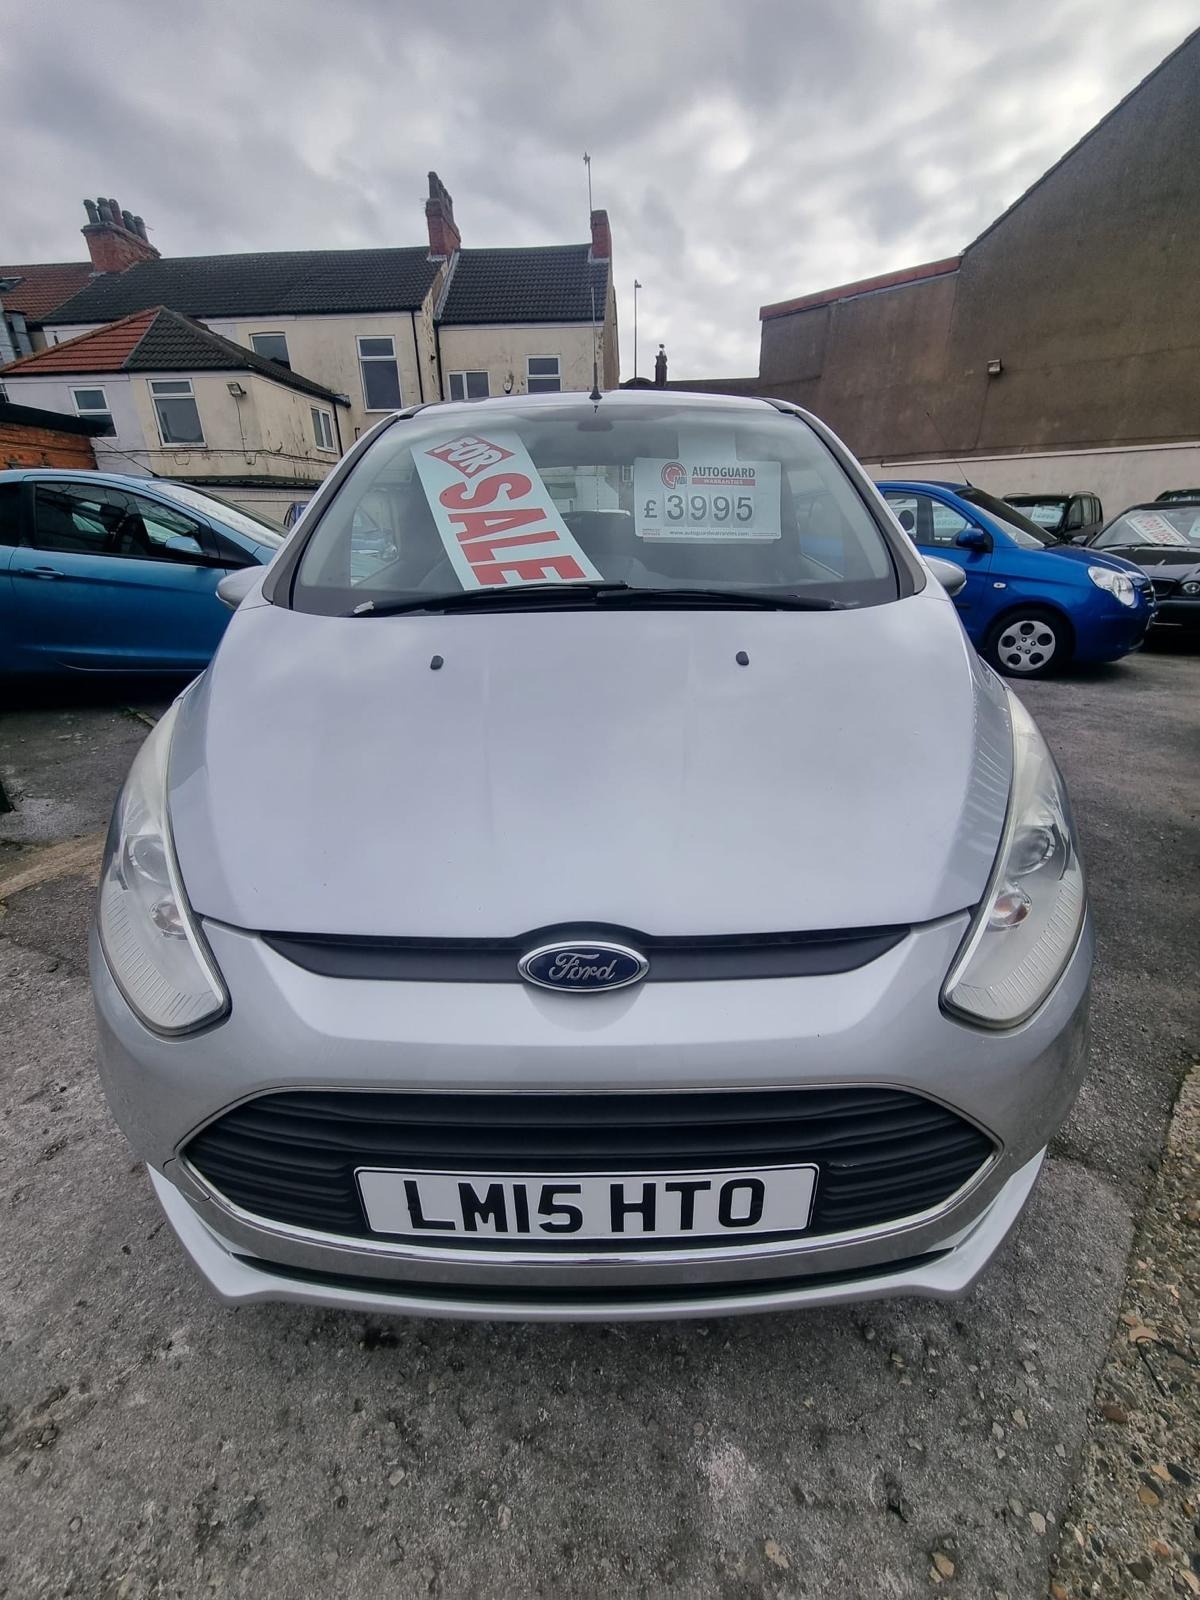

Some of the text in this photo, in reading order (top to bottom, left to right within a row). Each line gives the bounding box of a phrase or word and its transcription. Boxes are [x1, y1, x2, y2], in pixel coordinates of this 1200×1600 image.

[434, 437, 503, 473] FOR
[692, 467, 755, 478] AUTOGUARD
[439, 473, 587, 585] SALE
[548, 952, 616, 980] Ford
[403, 1178, 766, 1234] LM15 HTO
